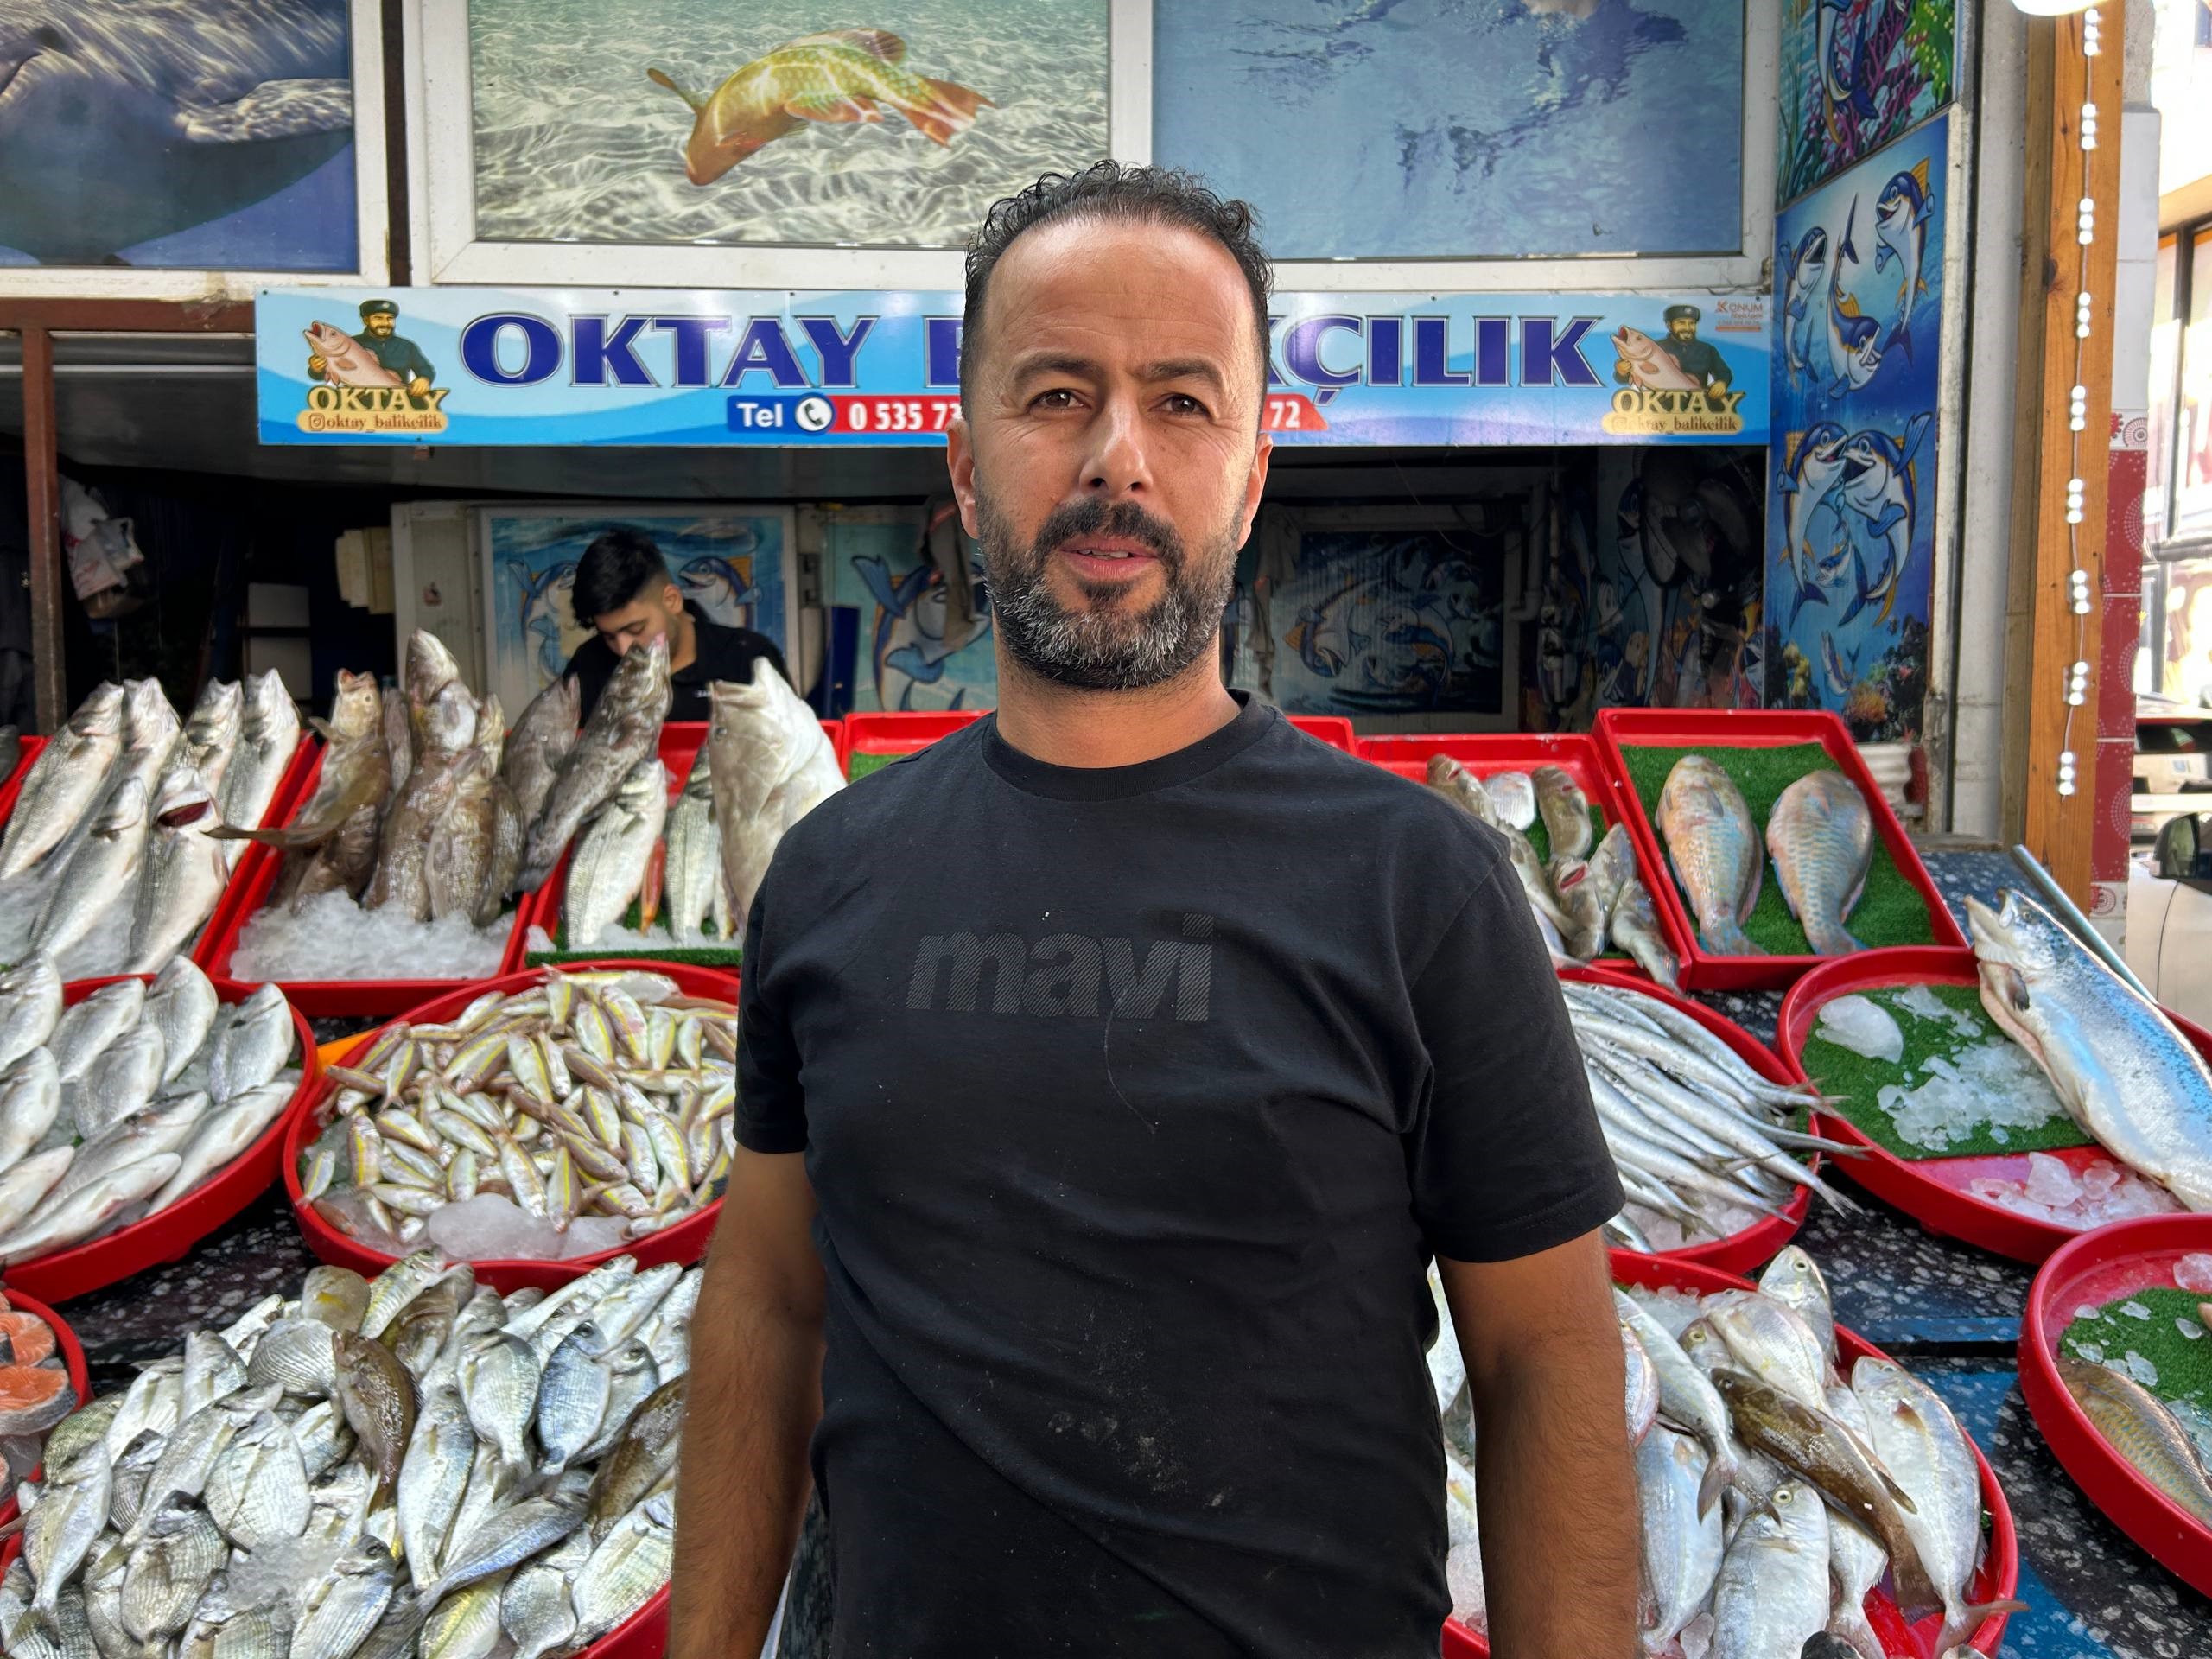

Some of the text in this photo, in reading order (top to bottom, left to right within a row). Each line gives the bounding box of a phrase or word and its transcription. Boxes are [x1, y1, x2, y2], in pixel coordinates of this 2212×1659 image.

[461, 312, 880, 388] OKTAY
[308, 386, 450, 412] OKTAY
[1612, 389, 1746, 414] OKTAY
[736, 403, 783, 428] Tel
[849, 402, 868, 430] 0
[874, 402, 924, 431] 535
[1269, 400, 1301, 429] 72
[905, 912, 1214, 1023] mavi
